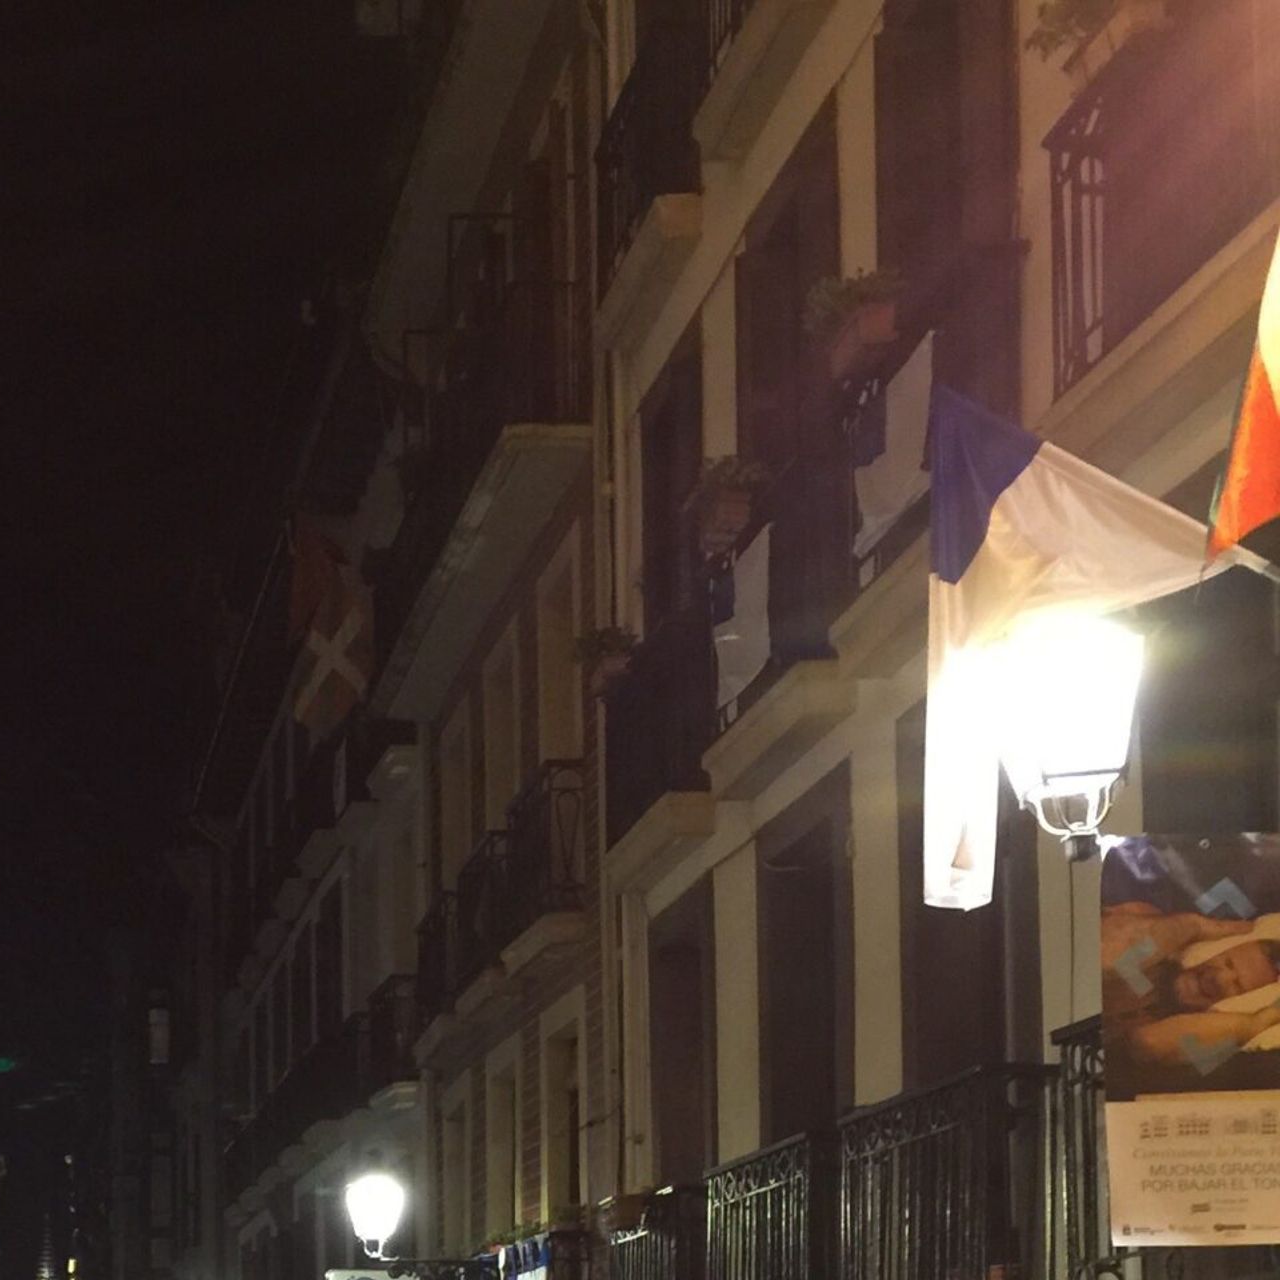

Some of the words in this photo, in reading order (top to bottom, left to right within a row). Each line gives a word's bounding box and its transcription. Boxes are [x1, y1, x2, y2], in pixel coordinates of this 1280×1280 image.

[1150, 1163, 1217, 1176] MUCHAS
[1141, 1179, 1174, 1193] POR
[1231, 1177, 1250, 1190] EL
